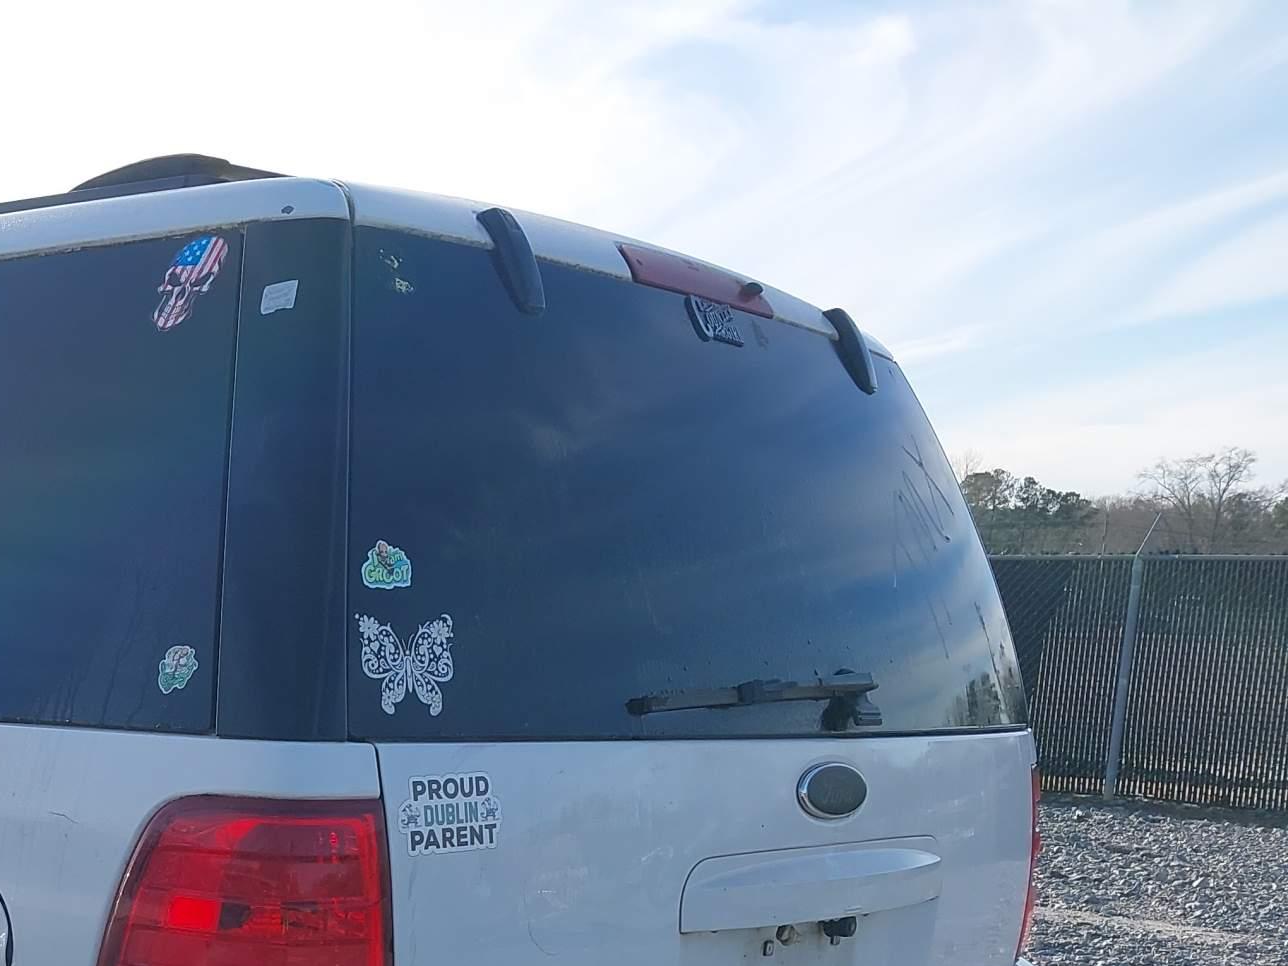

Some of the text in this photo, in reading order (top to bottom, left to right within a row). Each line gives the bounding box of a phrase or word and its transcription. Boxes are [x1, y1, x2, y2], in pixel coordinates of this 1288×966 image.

[412, 775, 490, 802] PROUD
[423, 801, 479, 828] DUBLIN
[410, 823, 497, 851] PARENT
